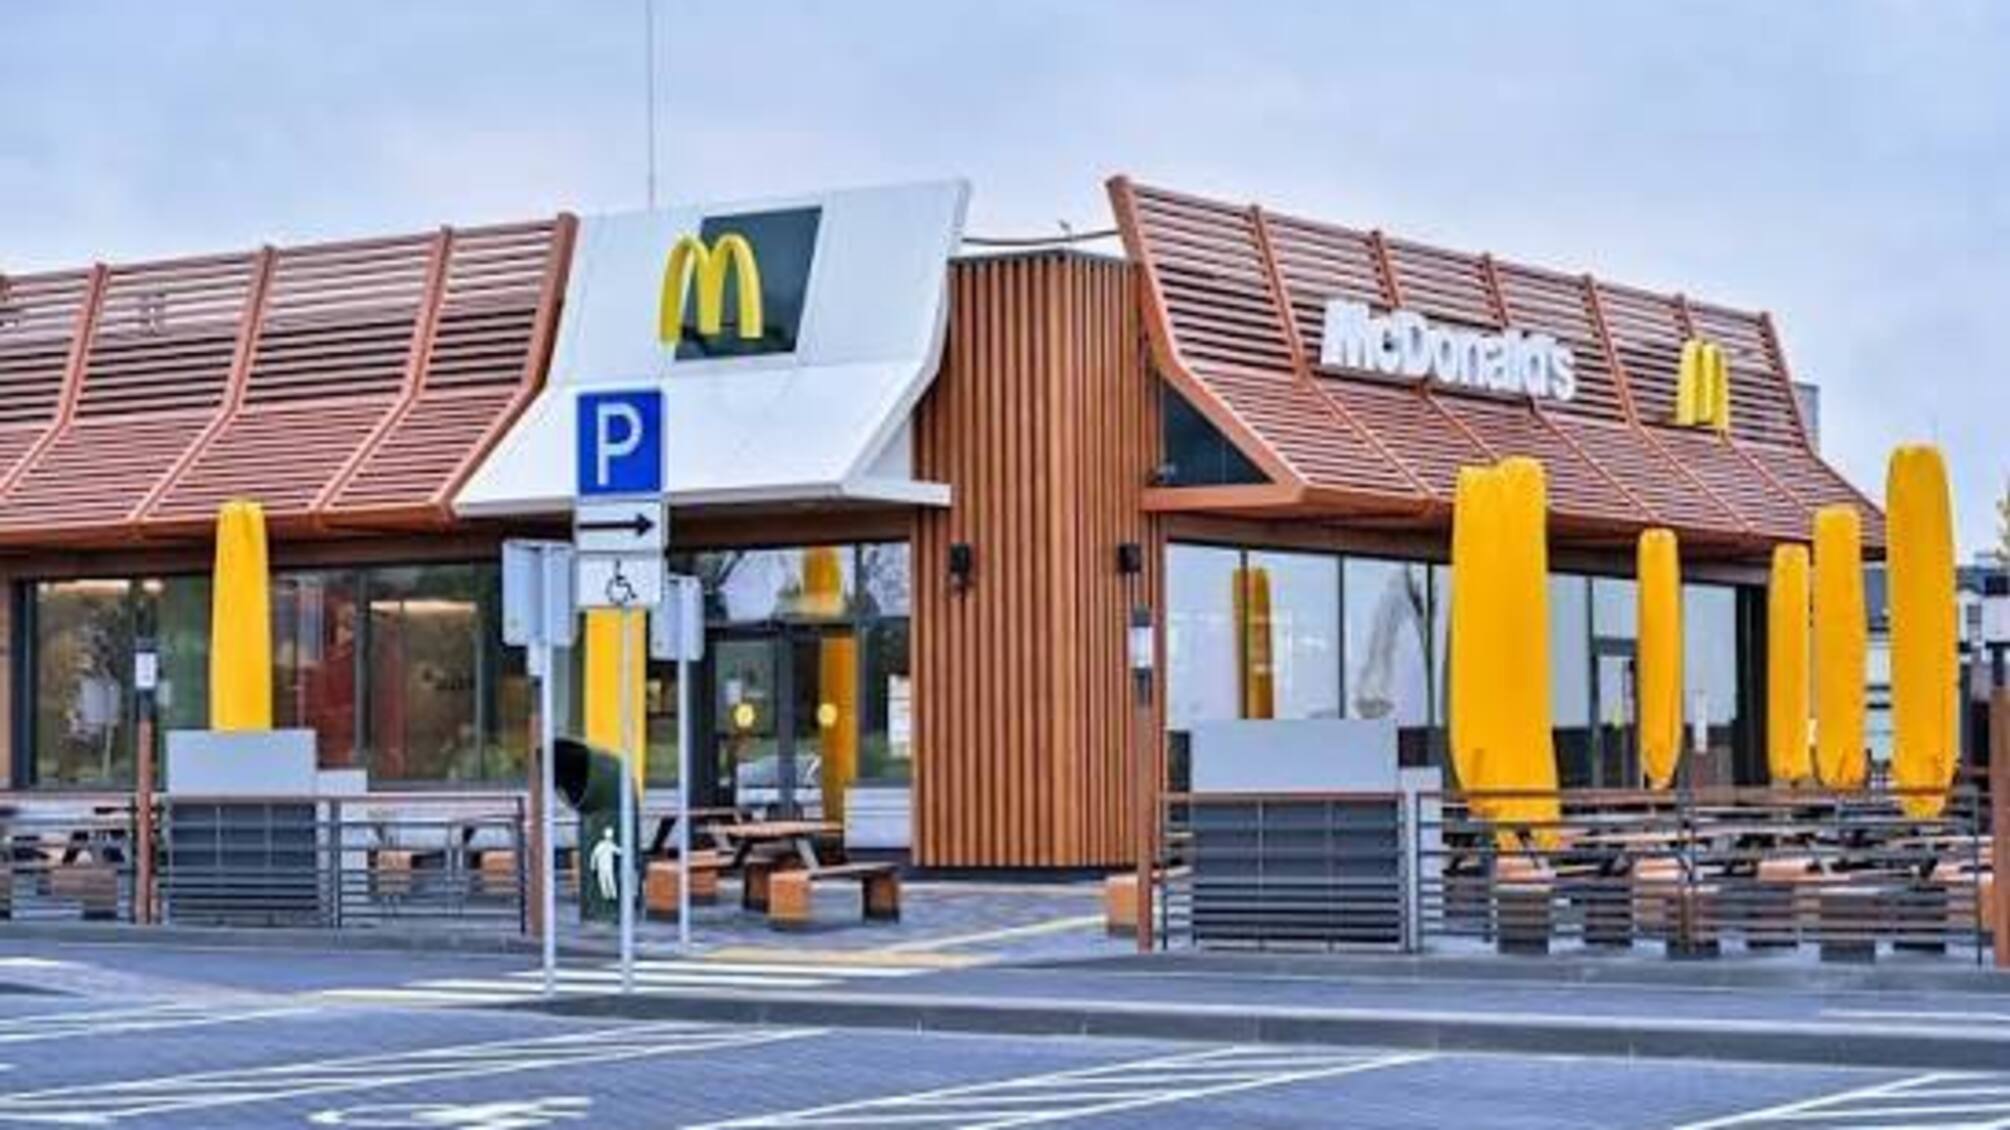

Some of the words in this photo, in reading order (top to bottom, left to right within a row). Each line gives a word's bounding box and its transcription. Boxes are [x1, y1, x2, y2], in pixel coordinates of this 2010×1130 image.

[660, 234, 763, 344] M
[1321, 300, 1575, 401] McDonald's
[597, 403, 643, 486] P
